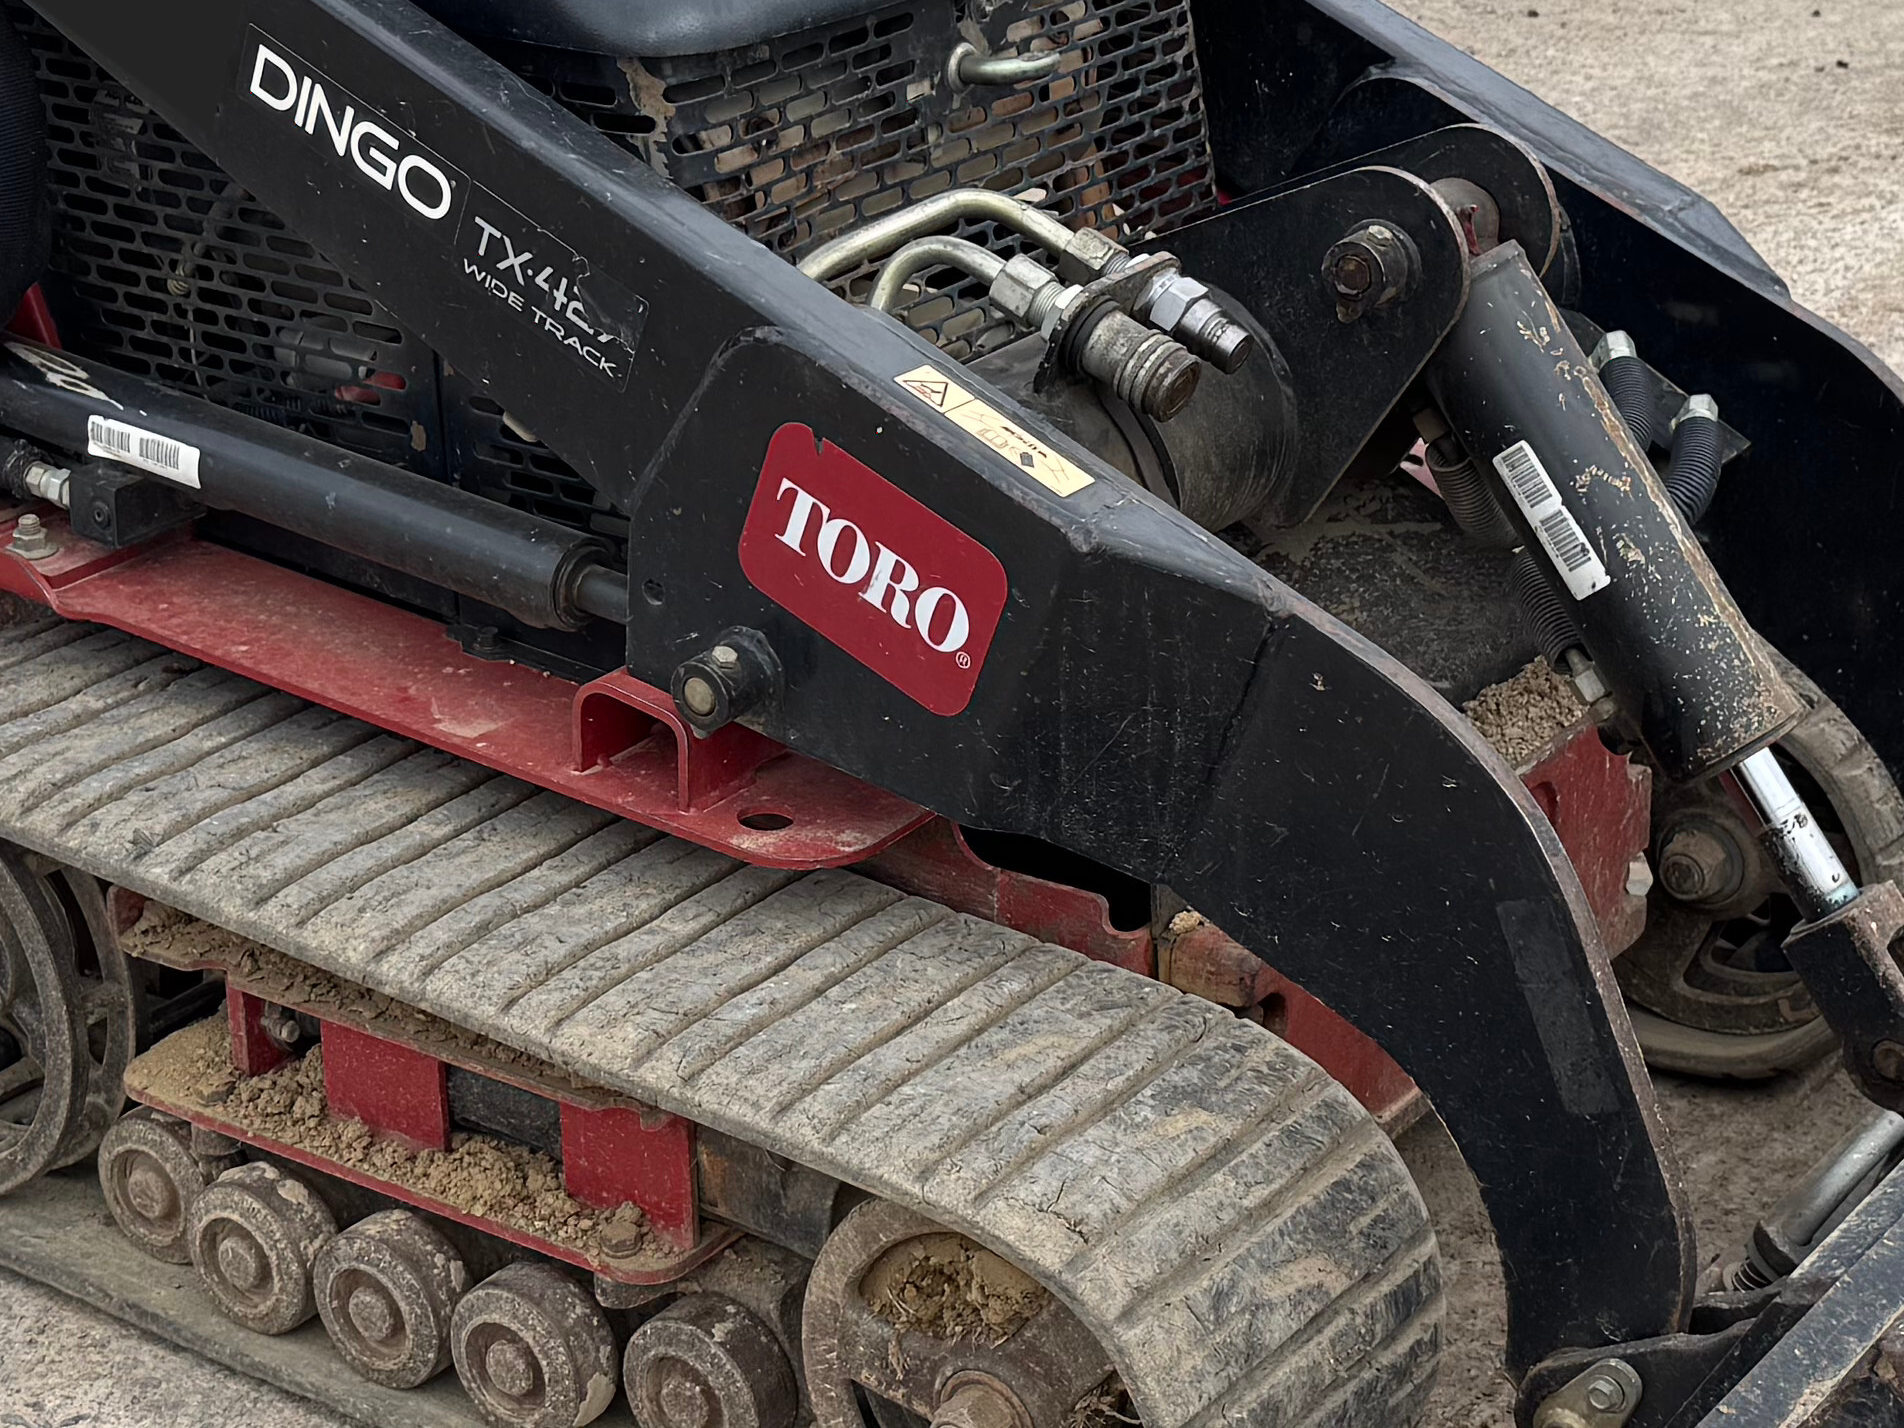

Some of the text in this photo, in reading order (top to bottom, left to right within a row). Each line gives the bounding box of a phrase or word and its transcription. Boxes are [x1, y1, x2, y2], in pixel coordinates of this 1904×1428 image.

[249, 43, 453, 220] DINGO
[463, 258, 617, 379] WIDE TRACK
[774, 477, 971, 654] TORO
